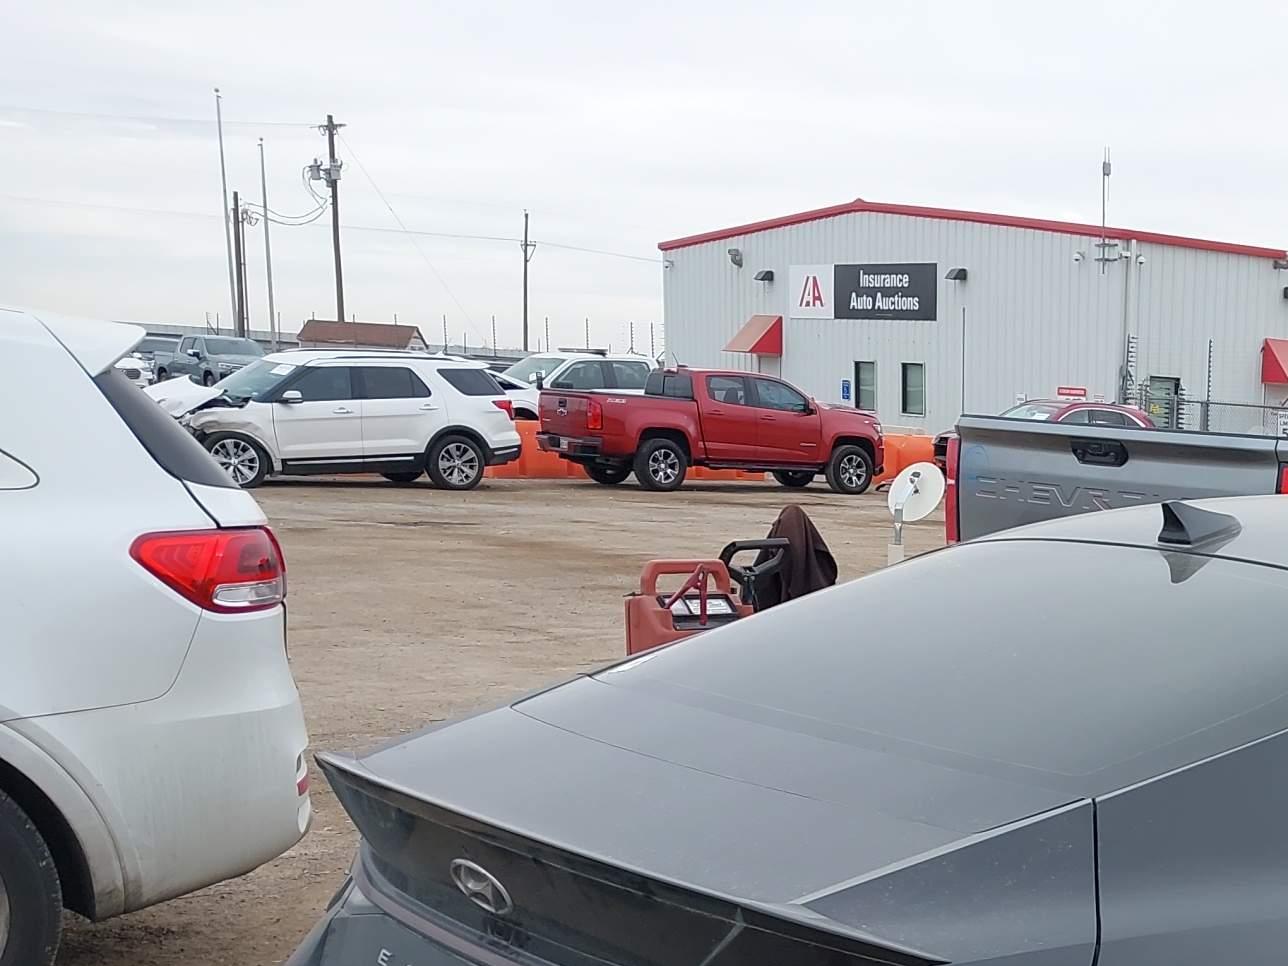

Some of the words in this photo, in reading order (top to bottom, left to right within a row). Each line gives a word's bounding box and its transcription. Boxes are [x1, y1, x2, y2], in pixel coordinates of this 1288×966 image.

[859, 269, 910, 288] Insurance
[849, 291, 873, 310] Auto
[874, 291, 920, 311] Auctions
[1282, 428, 1288, 438] 5
